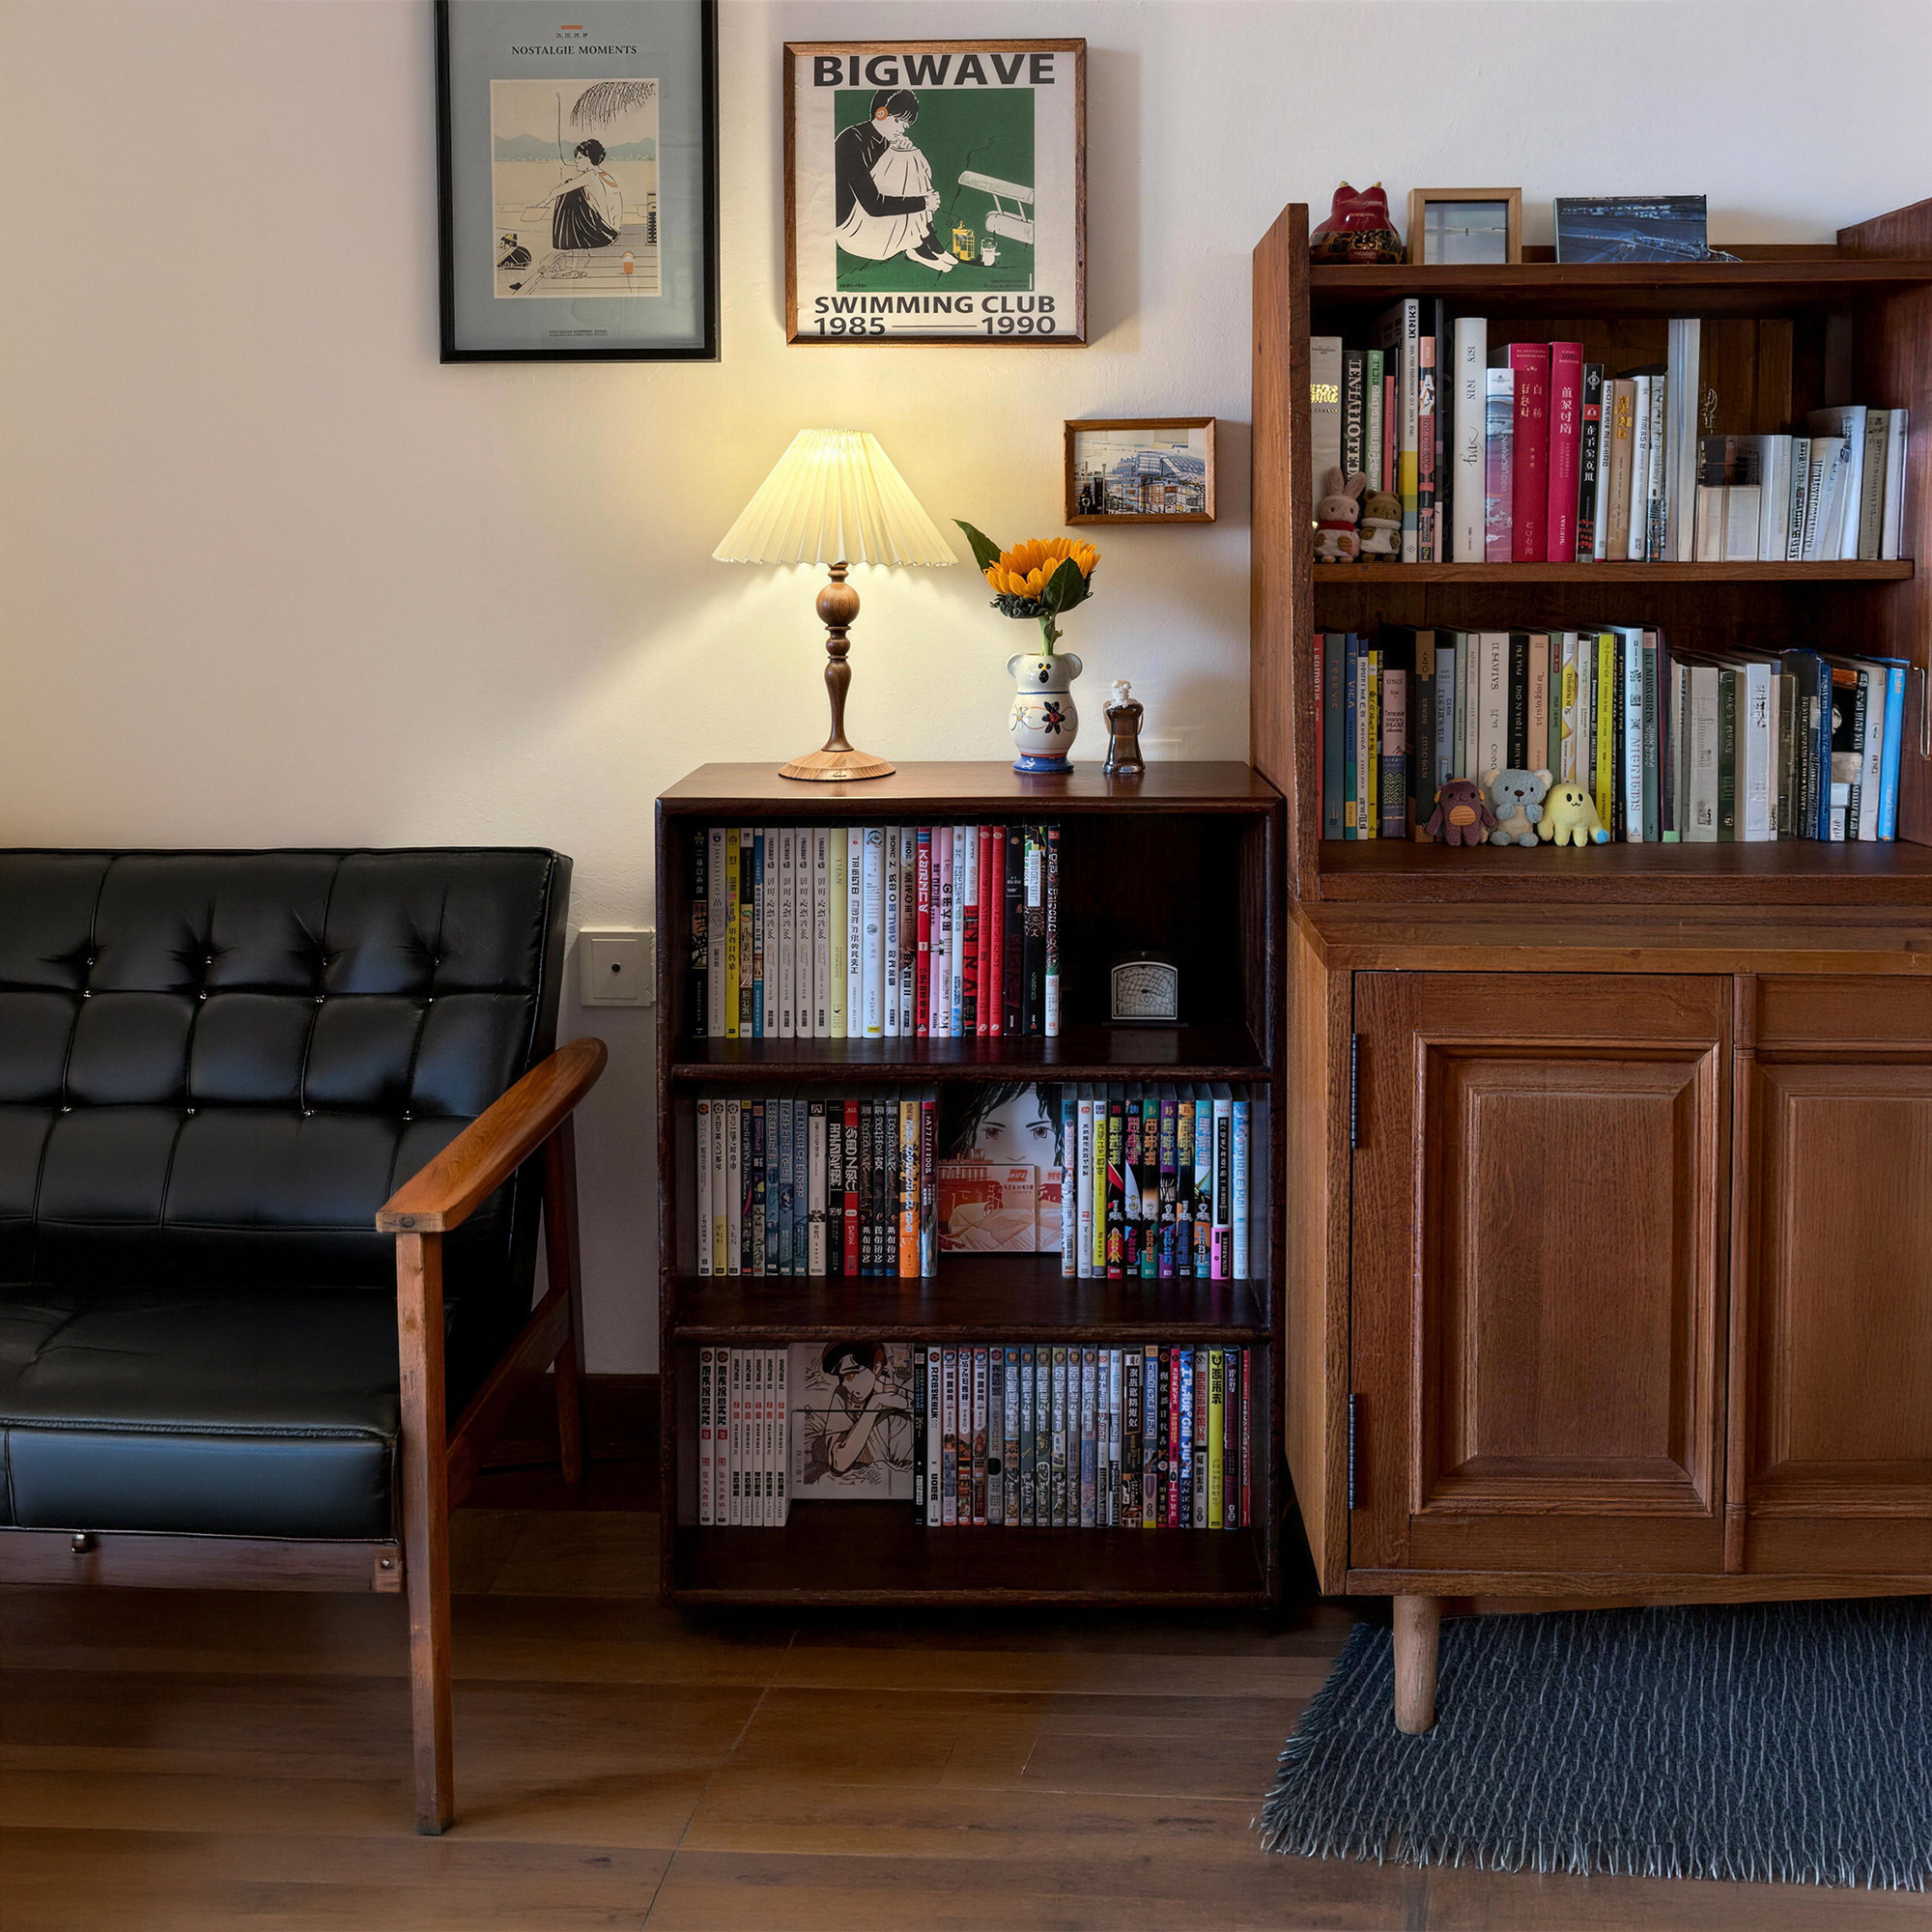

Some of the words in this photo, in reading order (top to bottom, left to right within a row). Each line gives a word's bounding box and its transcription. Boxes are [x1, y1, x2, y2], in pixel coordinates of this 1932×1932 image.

[511, 45, 575, 55] NOSTALGIE
[579, 45, 638, 55] MOMENTS
[813, 53, 1056, 87] BIGWAVE
[814, 296, 974, 314] SWIMMING
[981, 296, 1056, 314] CLUB
[813, 317, 886, 335] 1985
[981, 316, 1056, 335] 1990
